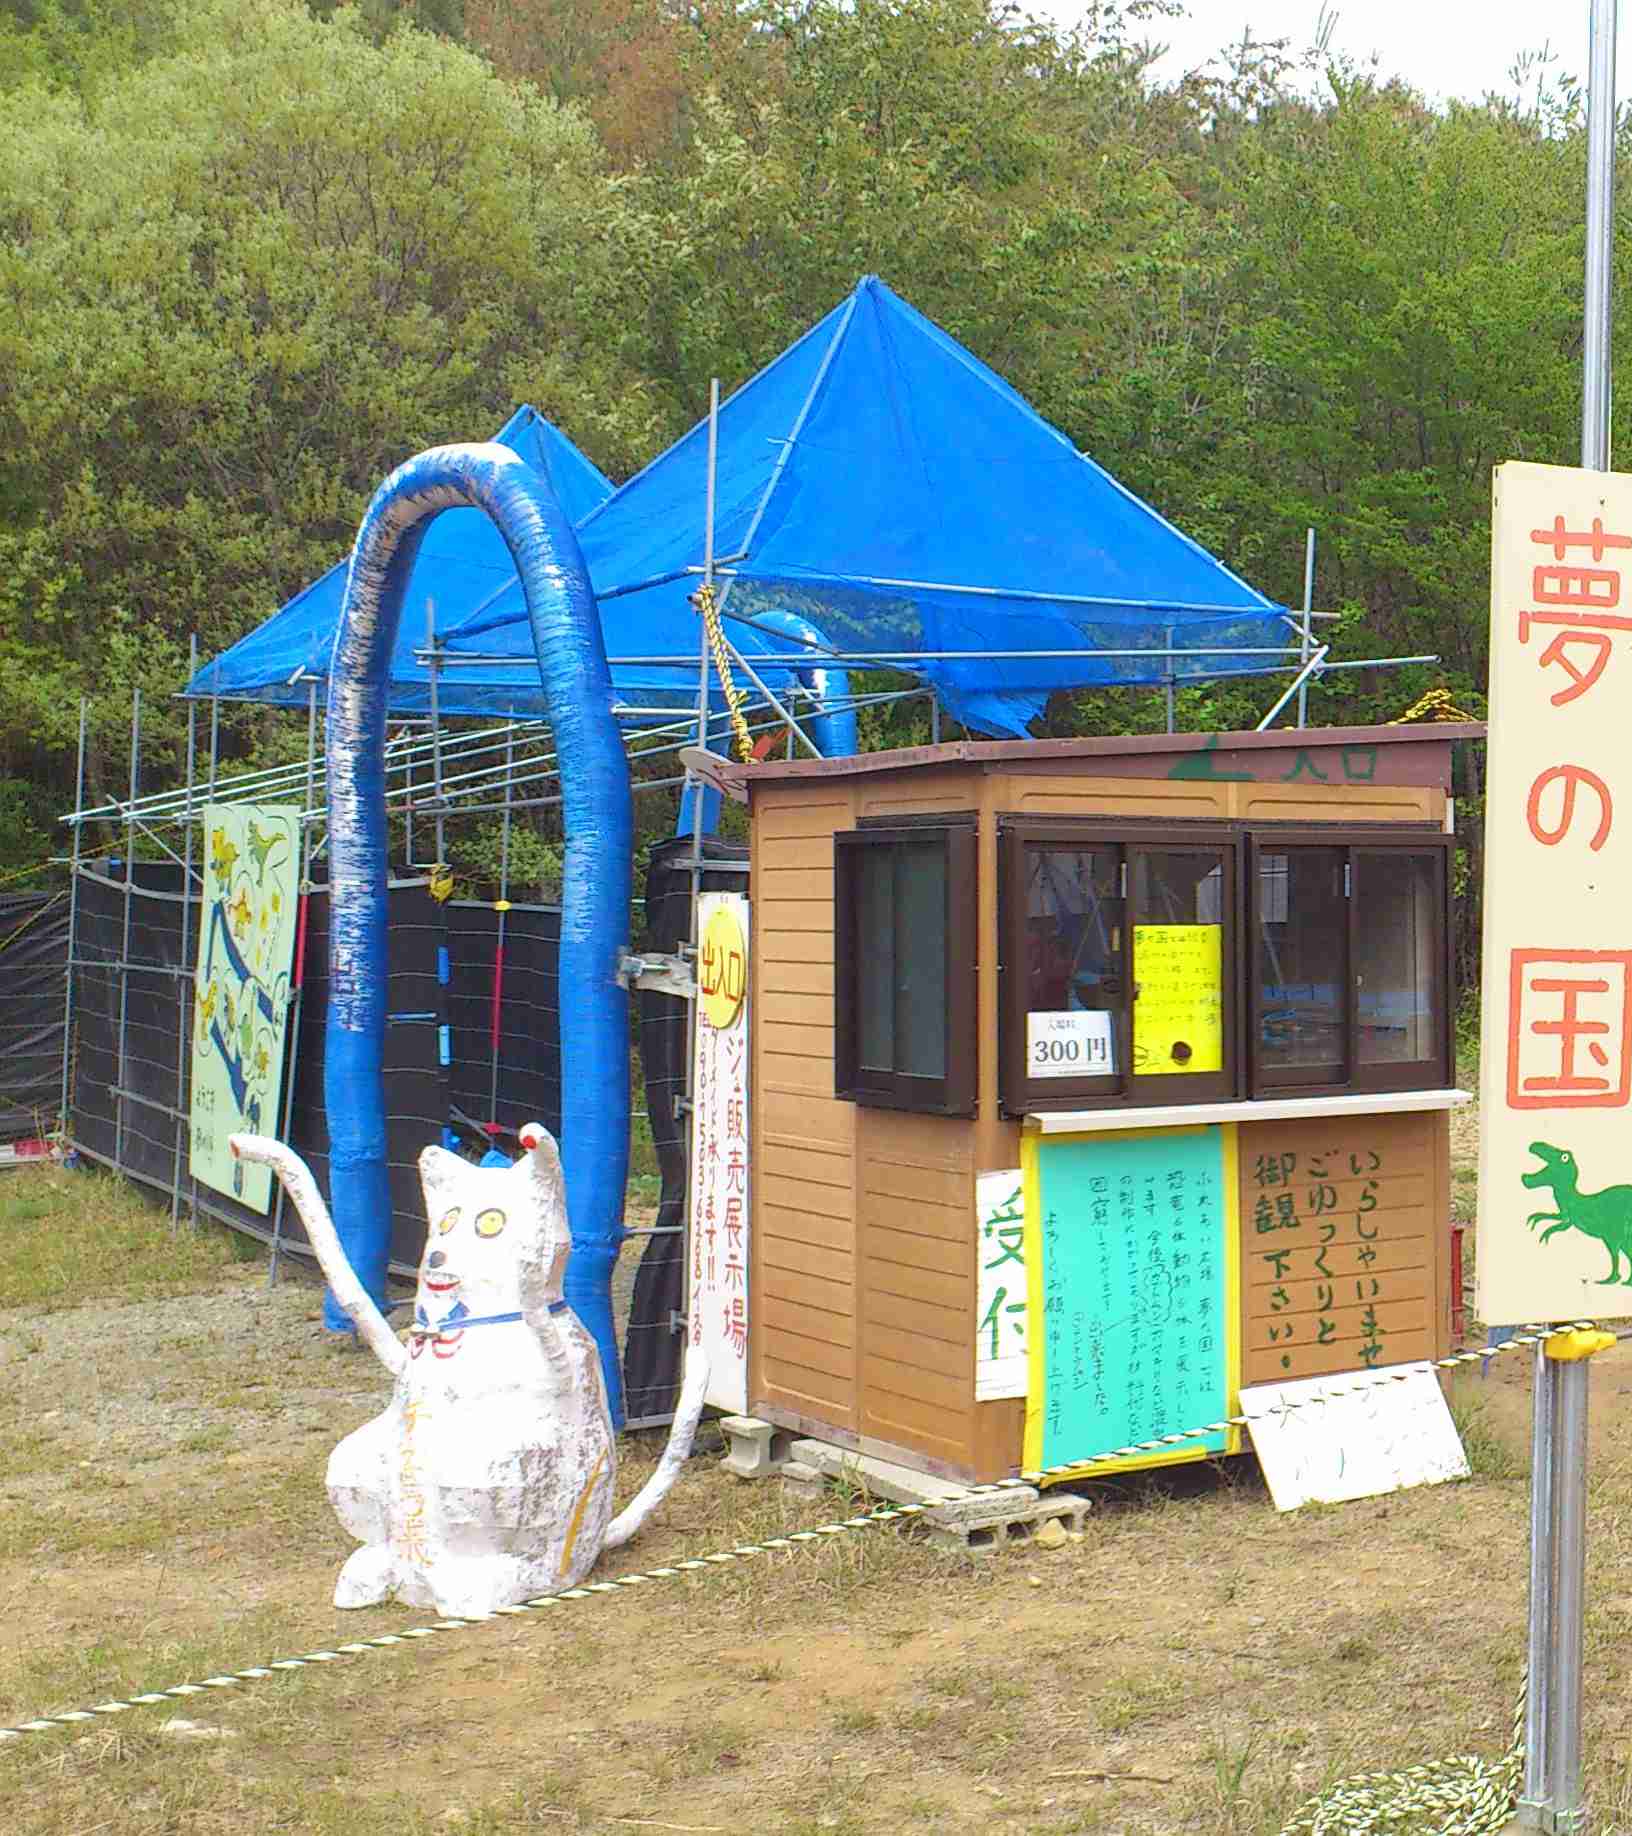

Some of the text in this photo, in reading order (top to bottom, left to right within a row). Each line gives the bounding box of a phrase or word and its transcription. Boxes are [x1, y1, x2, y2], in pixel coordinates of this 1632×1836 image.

[1281, 747, 1377, 781] 入口
[701, 936, 742, 1003] 出入口
[1034, 1037, 1106, 1063] 300円
[980, 1186, 1027, 1362] 受付
[1306, 1148, 1340, 1346] ごゆっくりと
